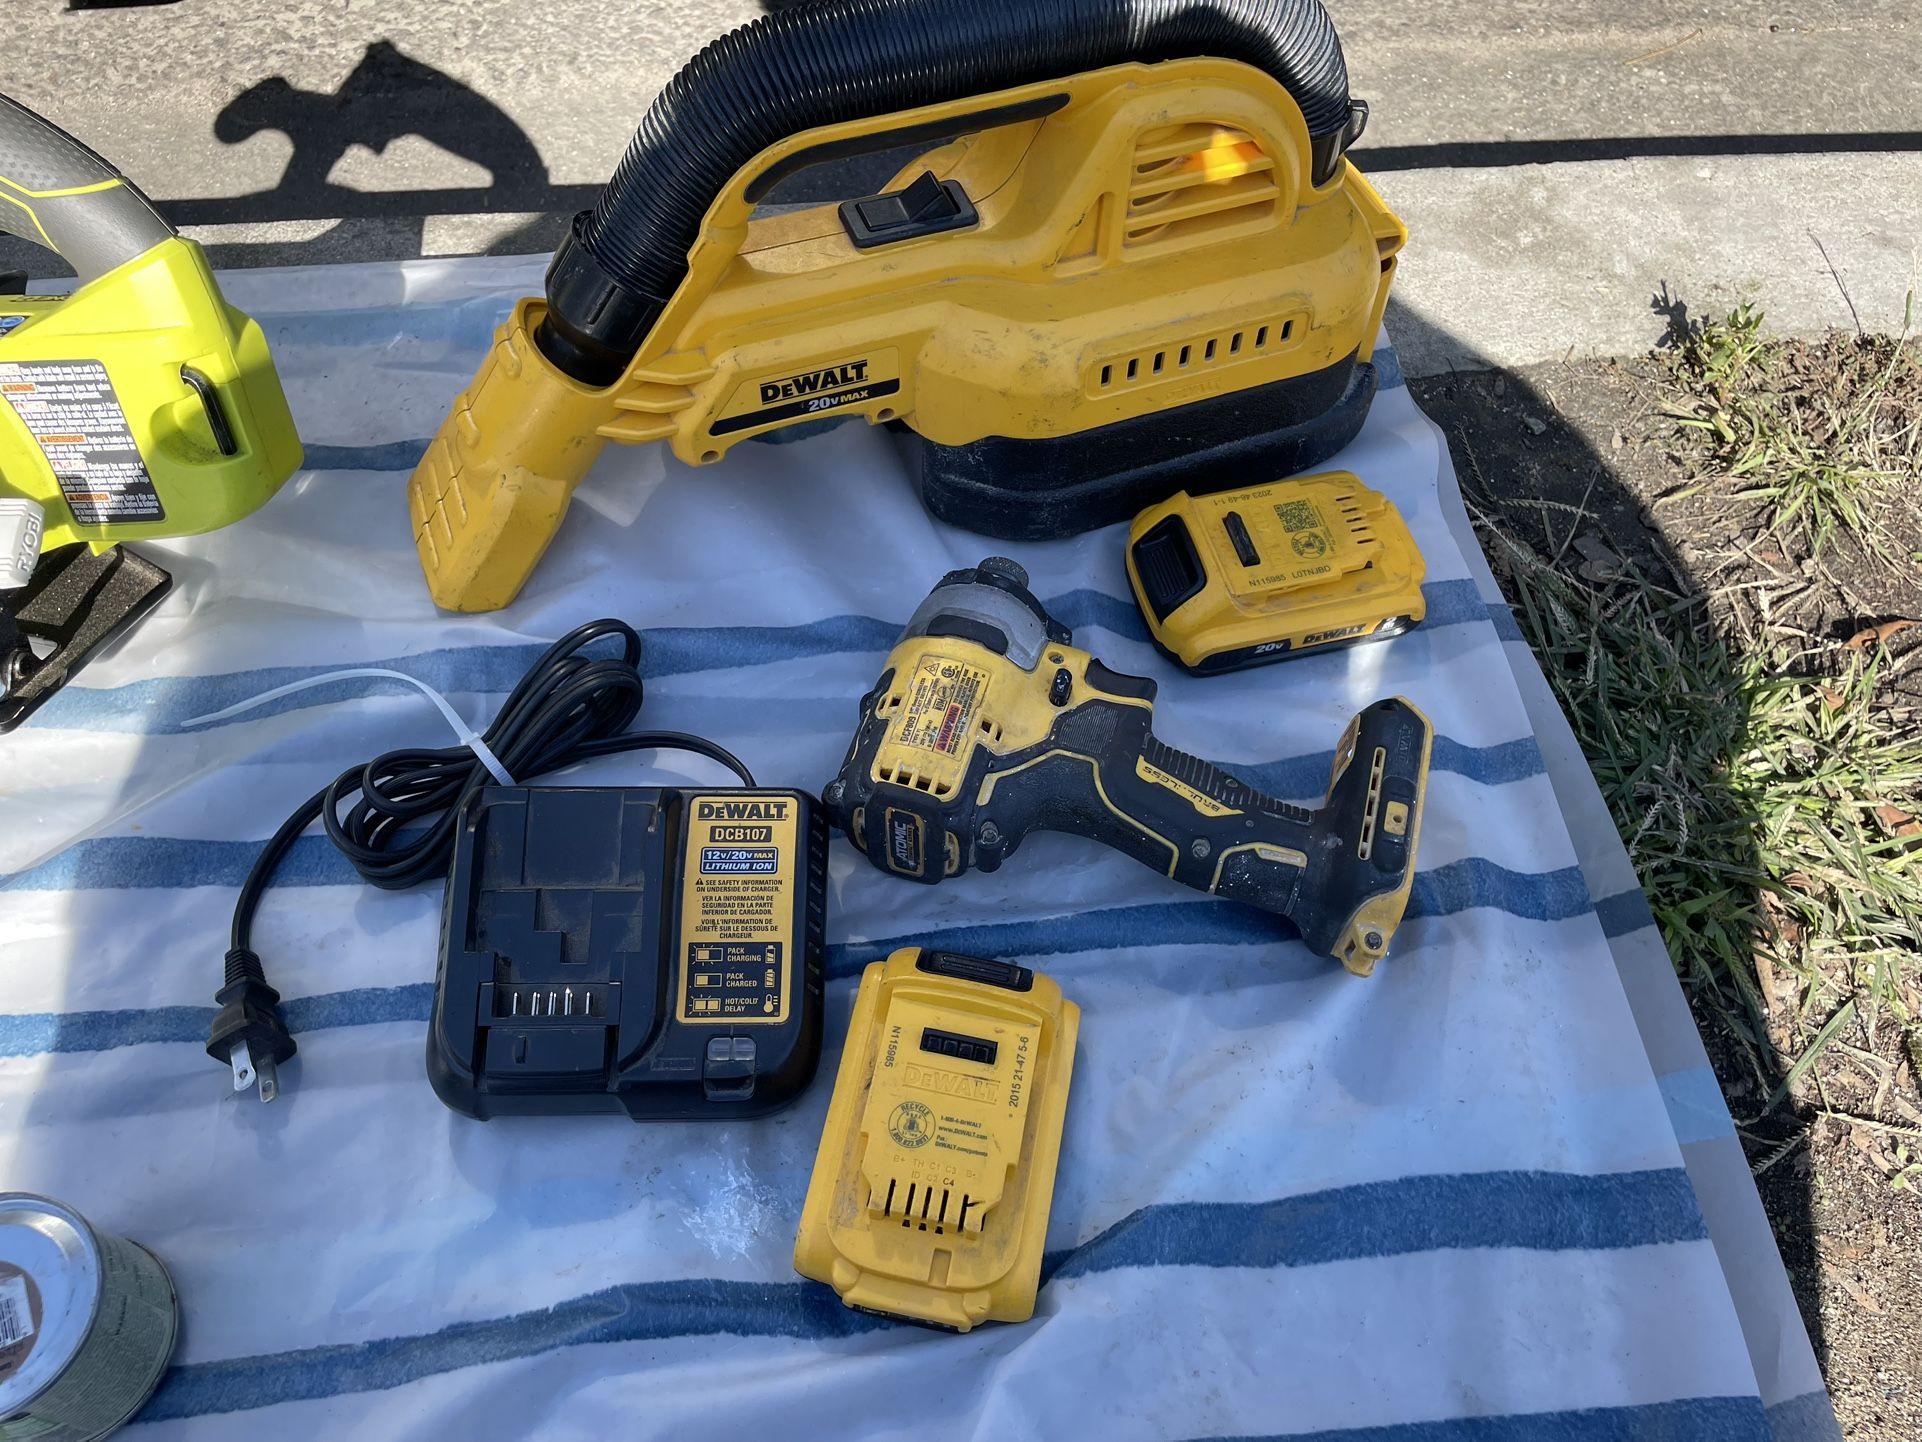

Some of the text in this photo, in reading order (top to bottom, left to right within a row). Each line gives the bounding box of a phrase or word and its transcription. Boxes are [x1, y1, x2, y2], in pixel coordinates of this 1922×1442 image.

[760, 361, 868, 404] DEWALT
[840, 390, 868, 402] MAX
[16, 513, 42, 572] RYOBI
[1249, 574, 1286, 587] N115985
[698, 802, 788, 820] DEWALT
[715, 828, 766, 840] DCB107
[895, 821, 908, 861] ATOMIC
[885, 1026, 902, 1068] N115985
[1009, 1036, 1029, 1108] 2015 21-47 5-6
[901, 1102, 930, 1116] RECYCLE
[943, 1178, 955, 1186] C4
